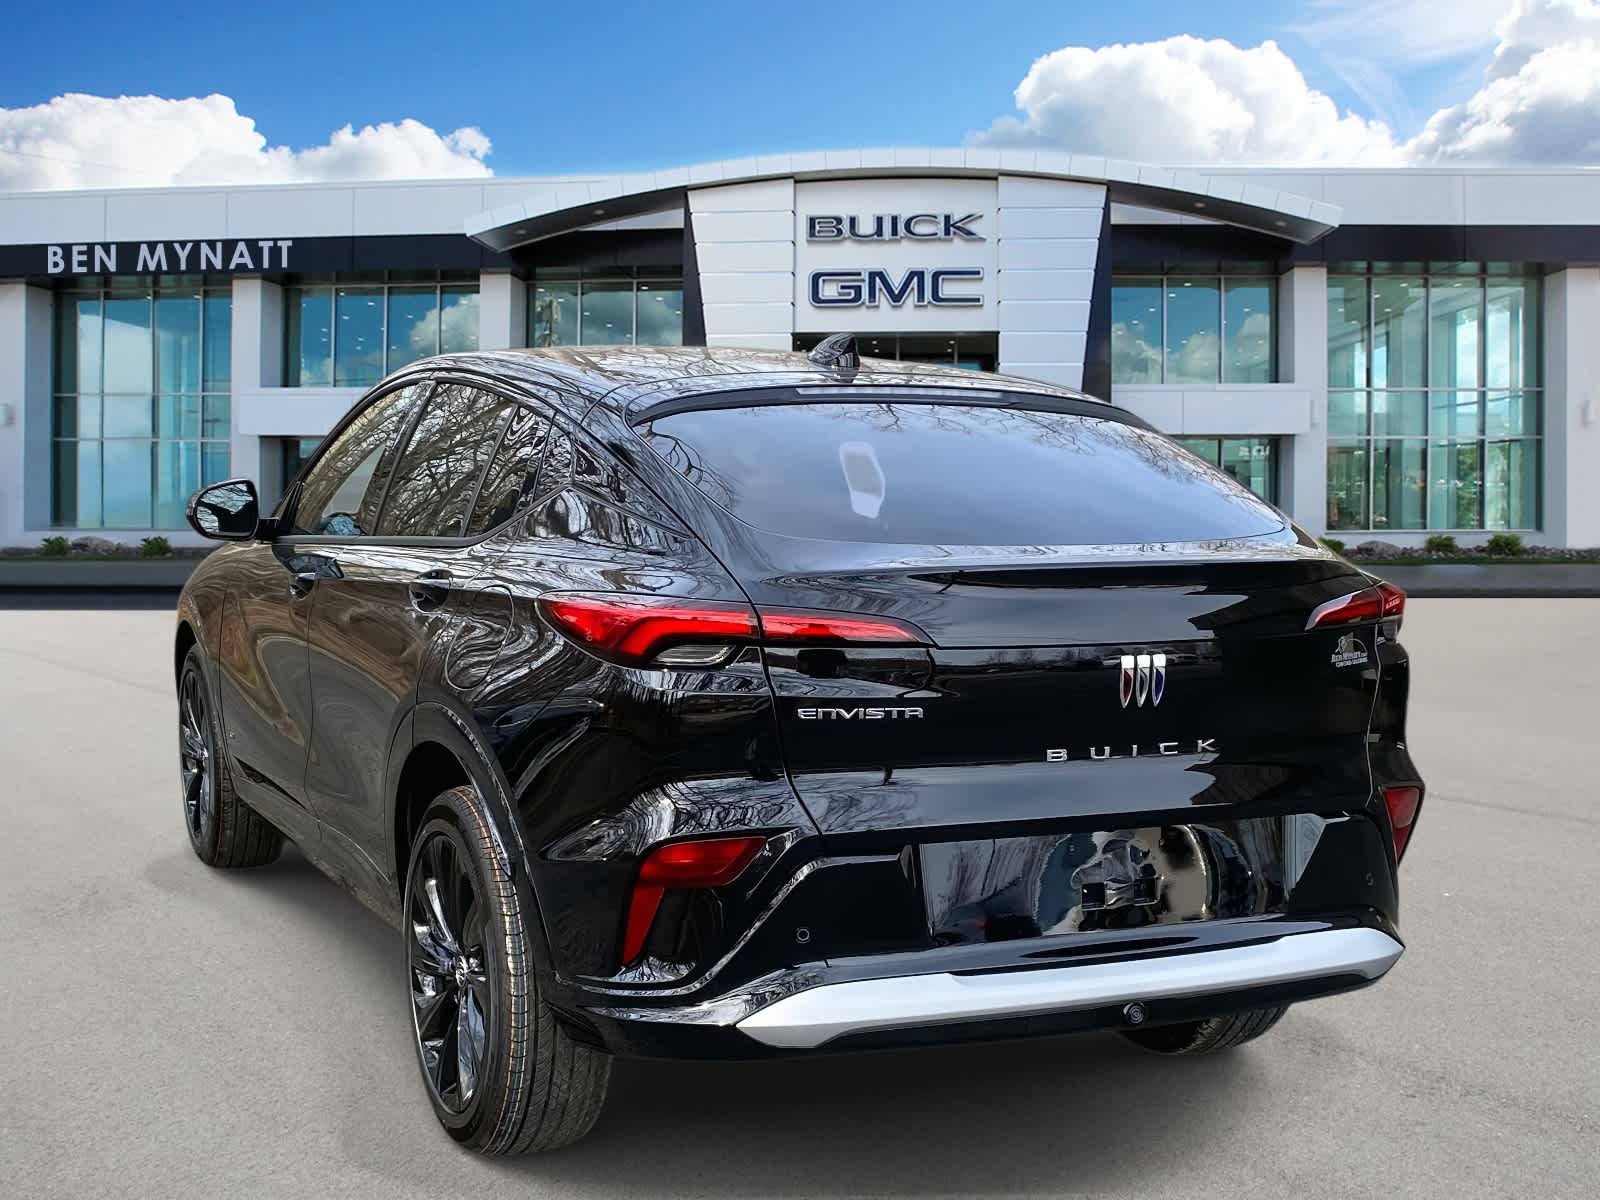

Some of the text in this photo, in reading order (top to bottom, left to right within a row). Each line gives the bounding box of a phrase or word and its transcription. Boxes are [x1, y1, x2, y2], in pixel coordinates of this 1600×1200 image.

[807, 213, 986, 241] BUICK
[47, 240, 293, 274] BEN MYNATT
[808, 267, 984, 308] GMC
[797, 707, 924, 720] ENVISTA
[1046, 738, 1216, 762] BUICK
